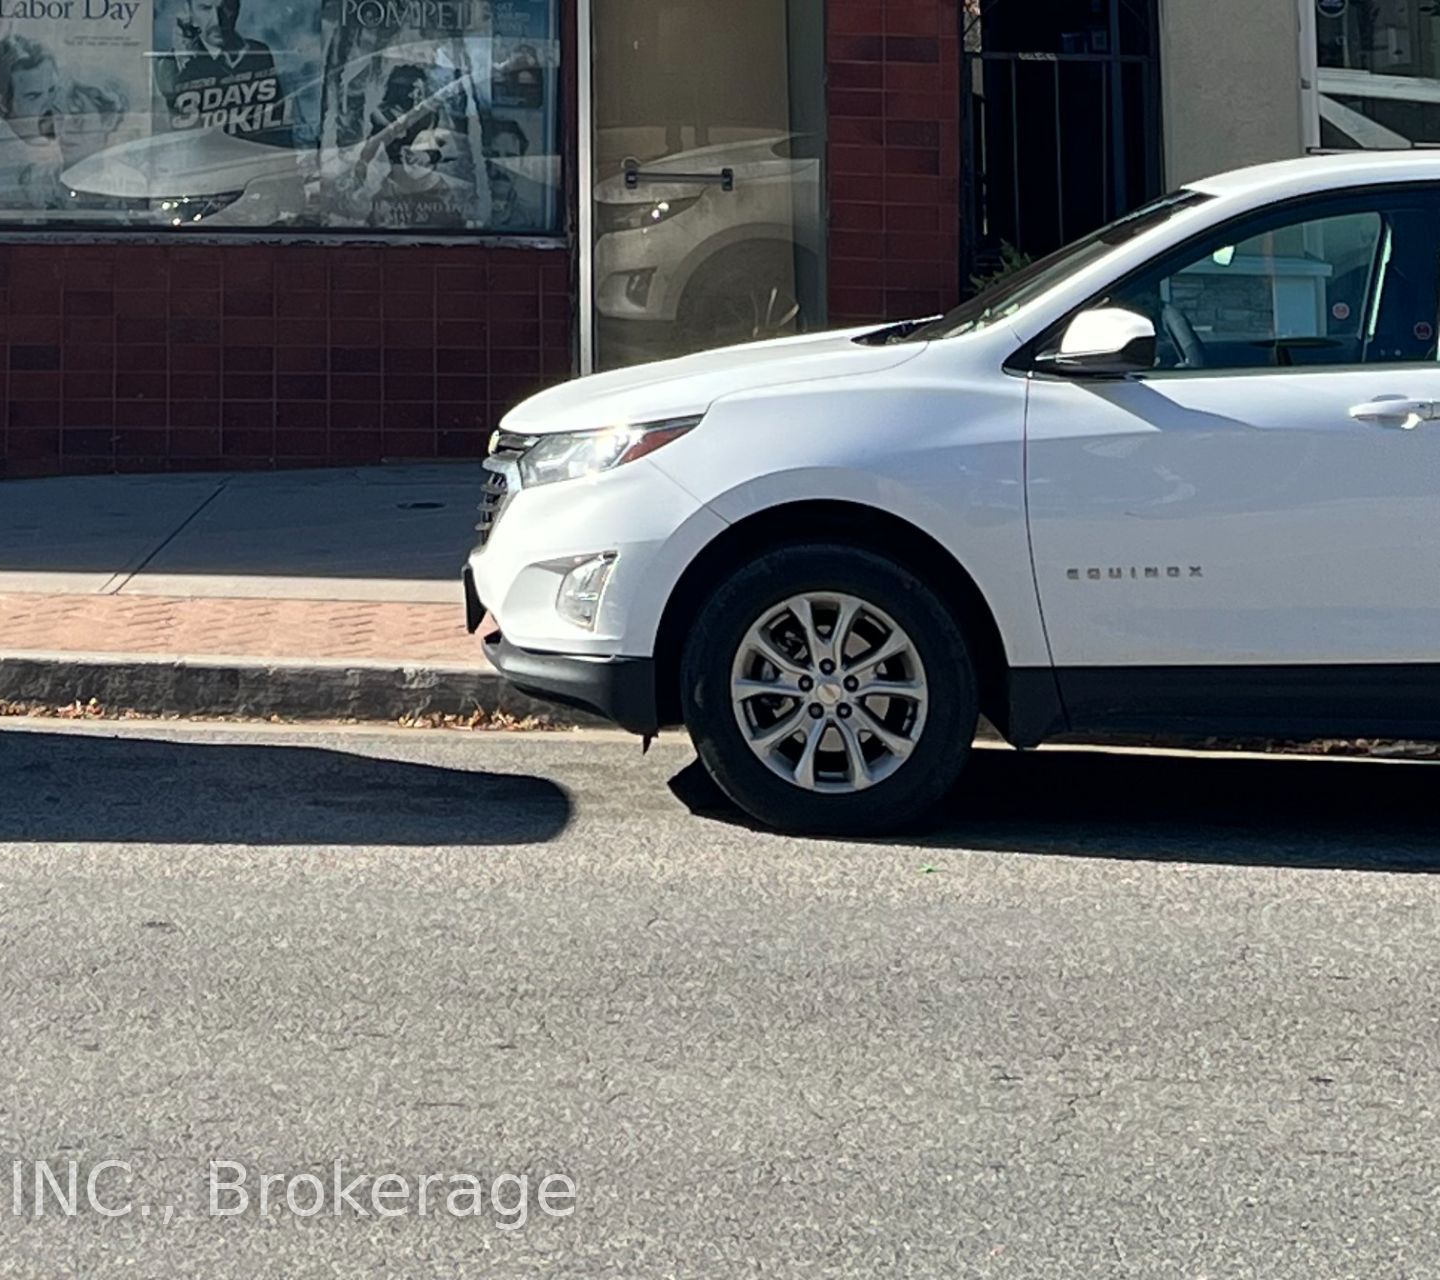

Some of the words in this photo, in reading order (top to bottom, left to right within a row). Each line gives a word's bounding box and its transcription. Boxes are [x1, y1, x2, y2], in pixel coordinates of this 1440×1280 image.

[172, 90, 201, 128] 3
[202, 78, 277, 112] DAYS
[201, 108, 228, 129] TO
[228, 97, 296, 134] KILL
[1066, 566, 1203, 580] EQUINOX
